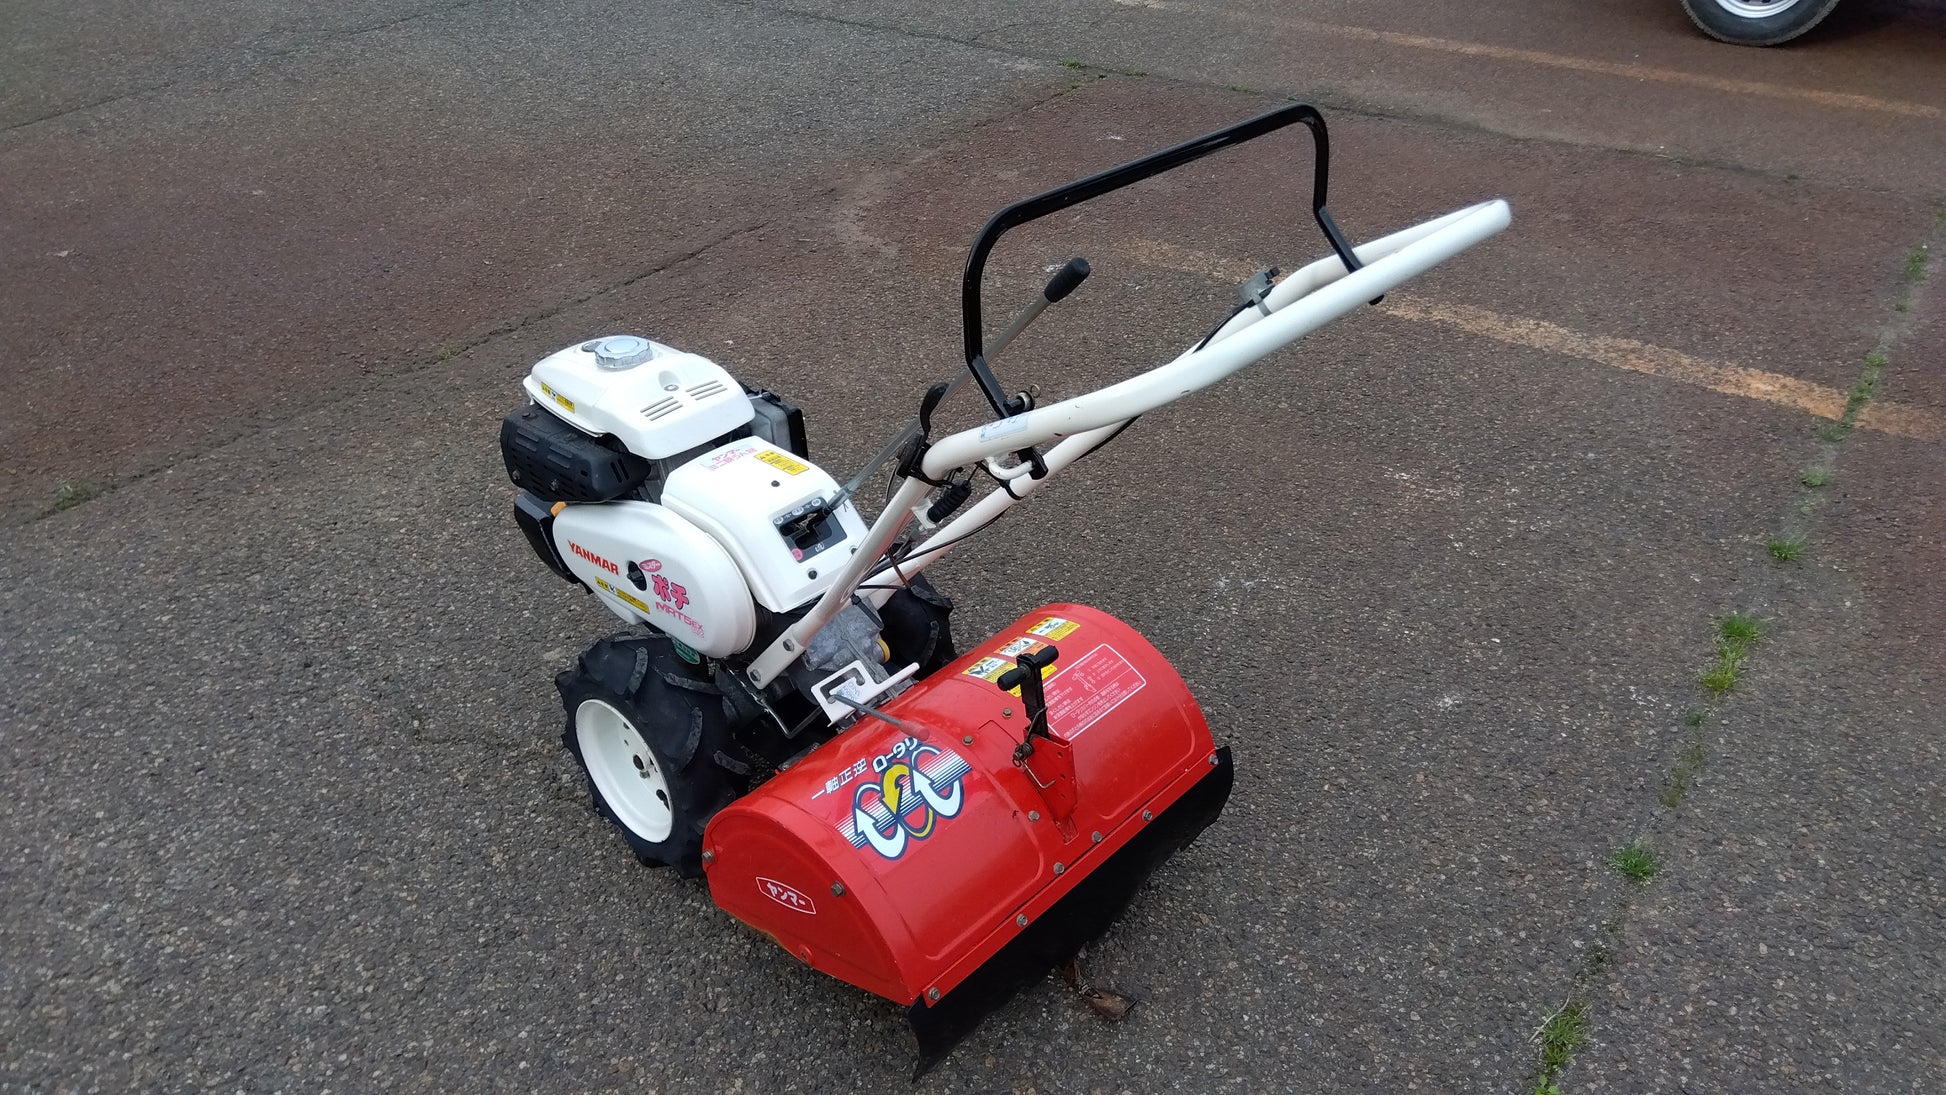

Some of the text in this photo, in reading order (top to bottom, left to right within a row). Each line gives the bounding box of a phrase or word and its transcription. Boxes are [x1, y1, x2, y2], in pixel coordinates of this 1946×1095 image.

[568, 540, 619, 576] YANMAR
[811, 757, 867, 800] 一軸正逆
[767, 882, 806, 906] ヤンマー
